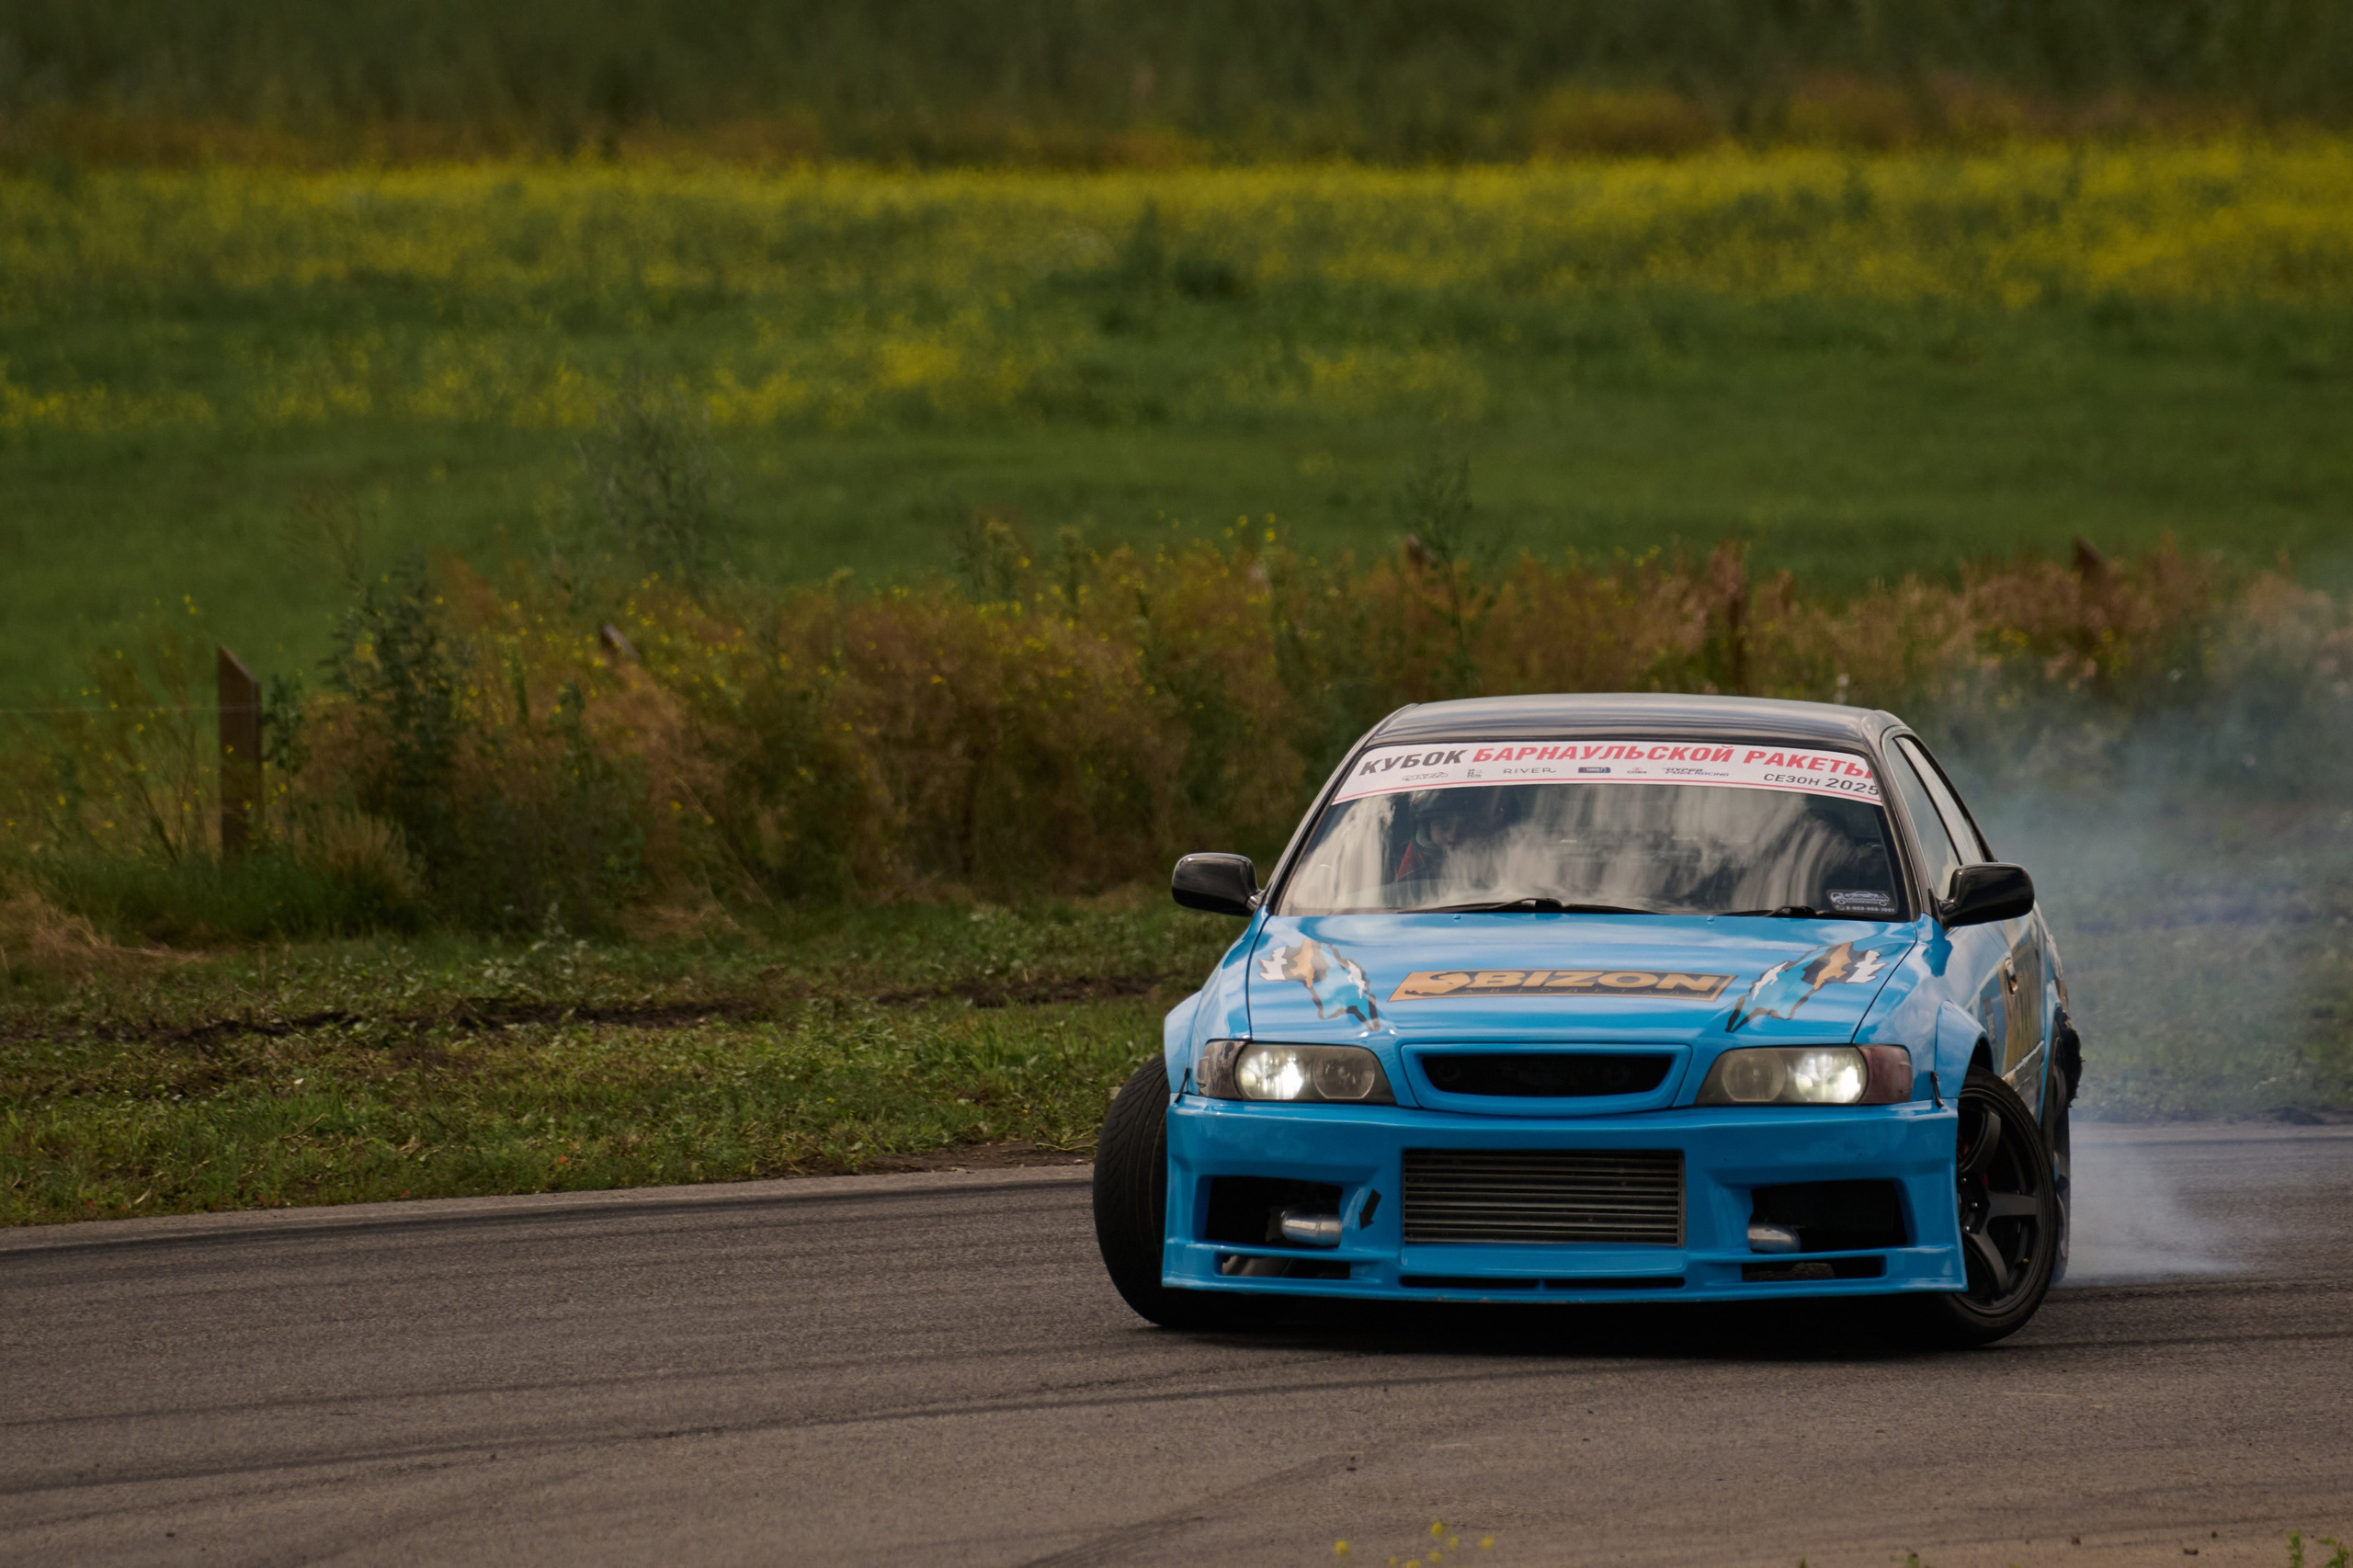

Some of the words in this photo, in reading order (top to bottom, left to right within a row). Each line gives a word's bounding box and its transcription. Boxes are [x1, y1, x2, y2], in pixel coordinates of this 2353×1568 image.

[1359, 749, 1468, 776] КУБОК
[1472, 745, 1734, 763] БАРНАУЛЬСКОЙ
[1743, 750, 1874, 779] РАКЕТЫ
[1763, 773, 1821, 786] СЕЗОН
[1824, 778, 1879, 796] 2025
[1465, 971, 1721, 992] BIZON
